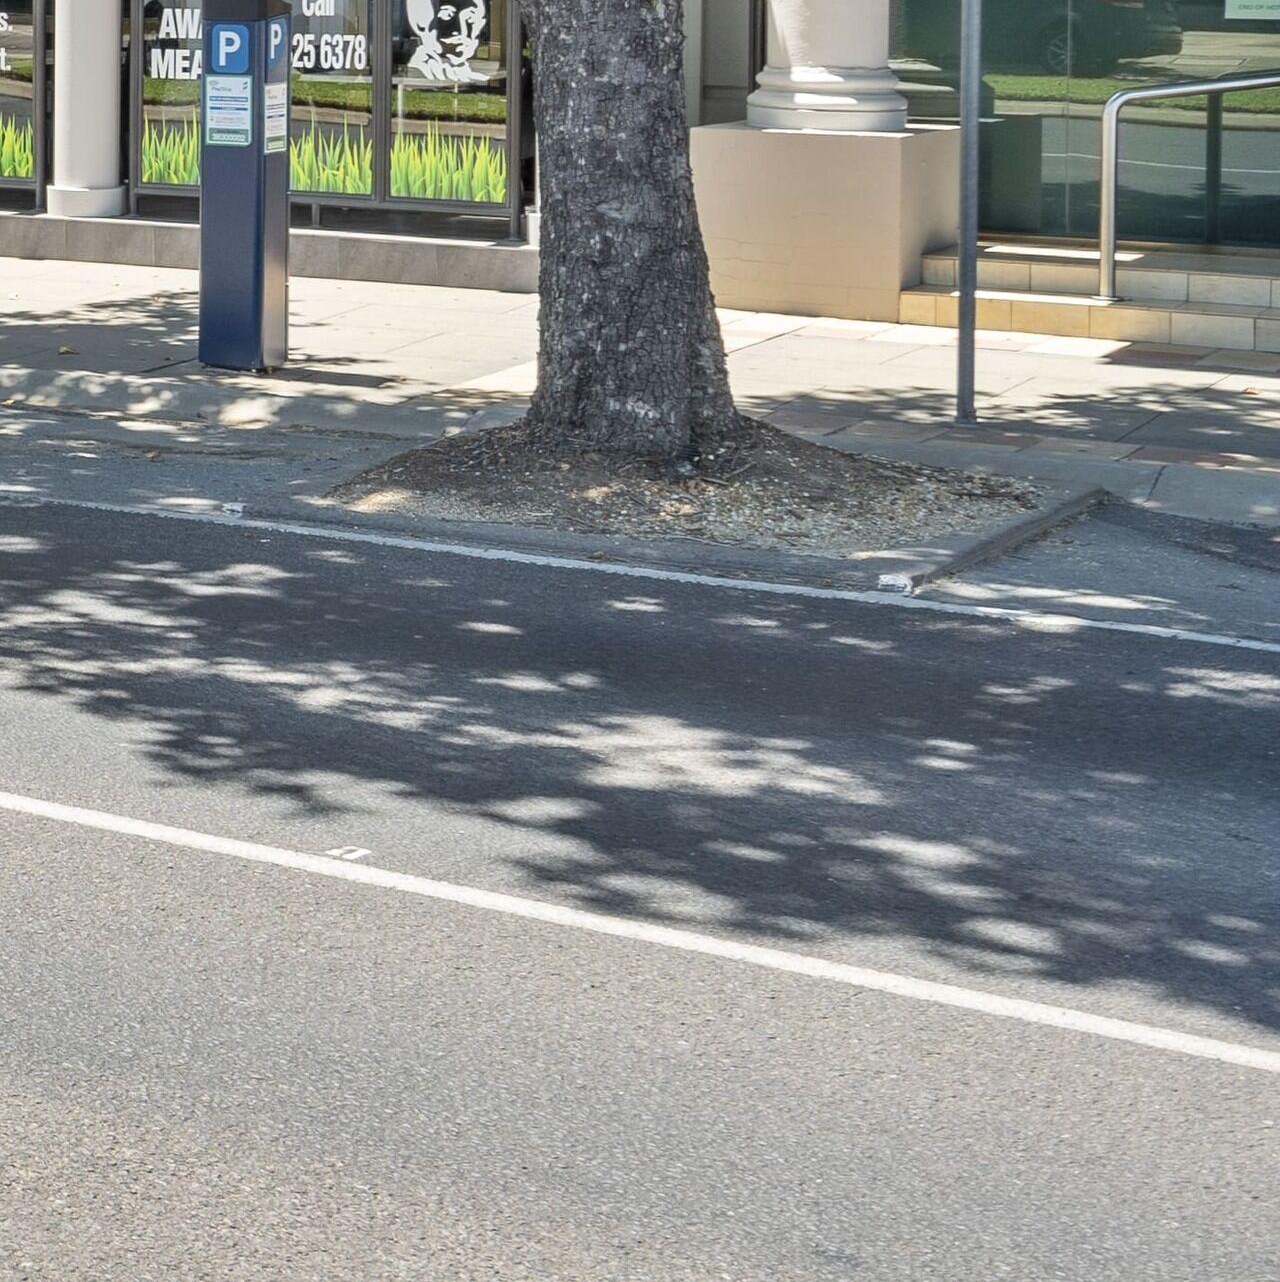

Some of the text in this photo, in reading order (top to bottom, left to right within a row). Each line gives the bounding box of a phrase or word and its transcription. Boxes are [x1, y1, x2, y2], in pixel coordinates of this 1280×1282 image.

[158, 8, 203, 39] AW
[270, 23, 282, 59] P
[150, 48, 203, 80] MEA
[219, 30, 241, 66] P
[291, 33, 366, 70] 25 6378
